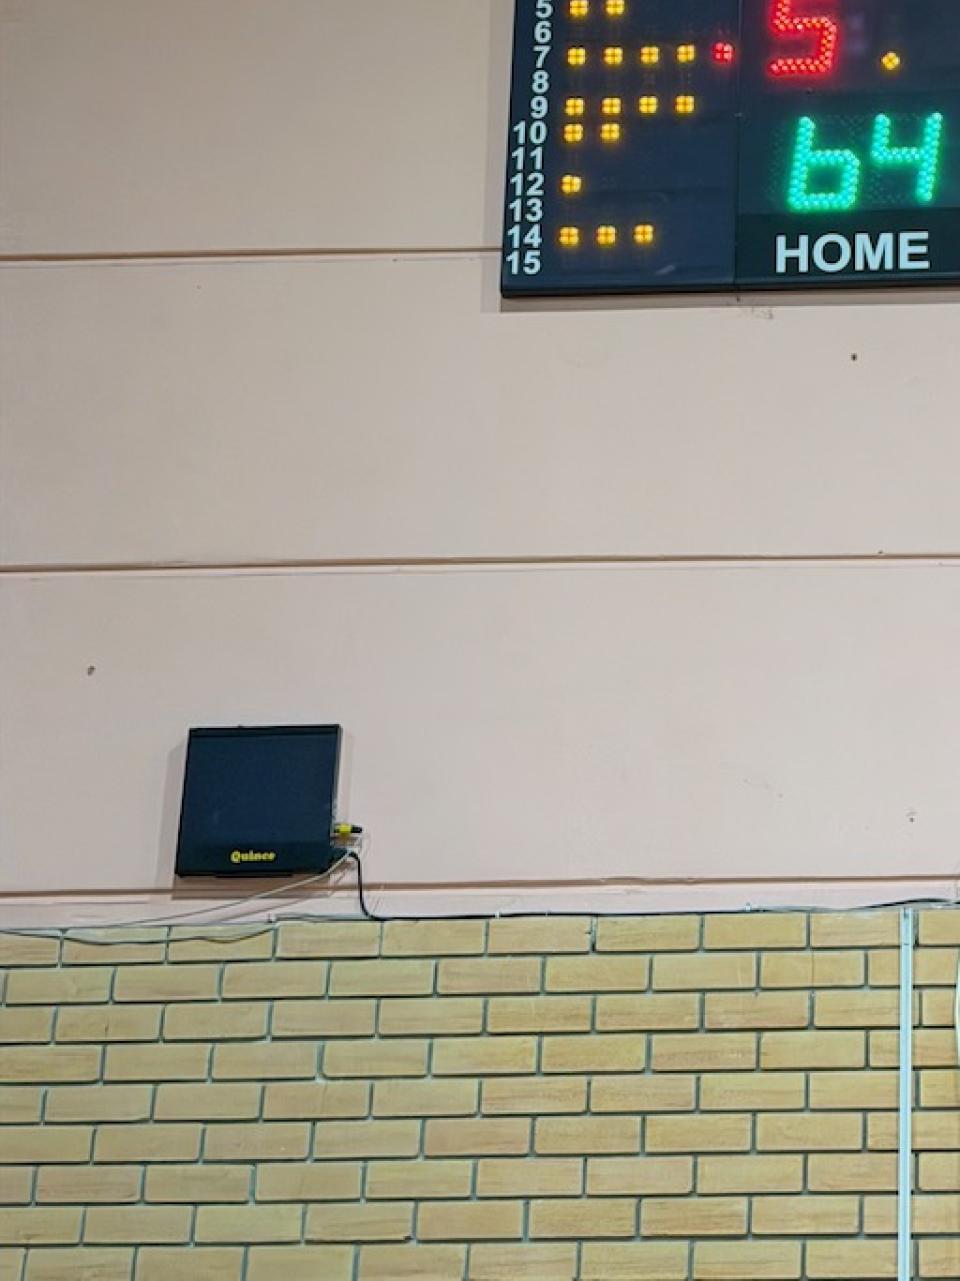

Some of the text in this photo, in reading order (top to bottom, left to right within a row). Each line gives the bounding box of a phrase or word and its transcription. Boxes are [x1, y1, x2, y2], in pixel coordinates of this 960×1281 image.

[534, 21, 551, 44] 6
[534, 46, 550, 69] 7
[532, 71, 549, 93] 8
[531, 96, 548, 120] 9
[514, 121, 547, 145] 10
[512, 146, 543, 170] 11
[787, 112, 943, 212] 64
[510, 173, 544, 196] 12
[509, 198, 543, 222] 13
[507, 224, 542, 248] 14
[506, 250, 541, 275] 15
[775, 230, 930, 273] HOME
